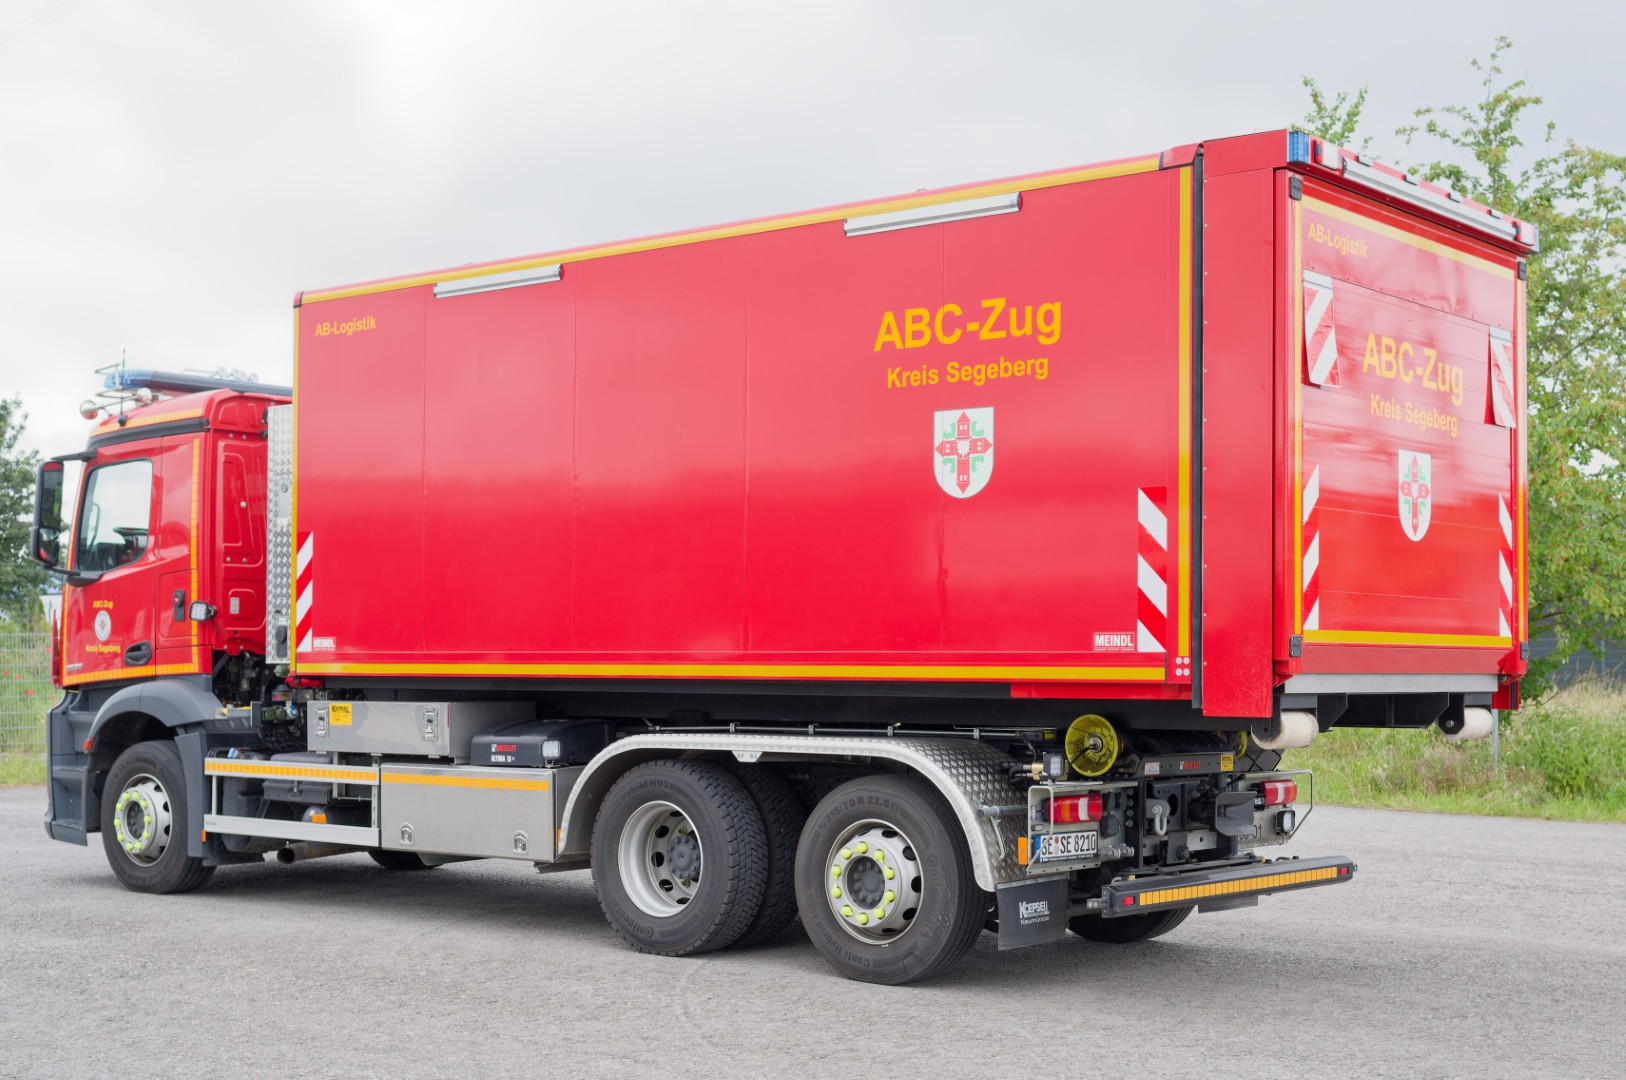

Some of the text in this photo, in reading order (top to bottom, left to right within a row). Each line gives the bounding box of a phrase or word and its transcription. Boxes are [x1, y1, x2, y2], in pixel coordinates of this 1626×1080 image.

[1308, 221, 1369, 259] AB-Logistik
[315, 315, 376, 336] AB-Logistik
[874, 297, 1062, 352] ABC-Zug
[887, 357, 1049, 389] Kreis Segeberg
[1362, 332, 1465, 407] ABC-Zug
[1370, 393, 1459, 438] Kreis Segeberg
[93, 600, 113, 609] ABC-Zug
[98, 643, 121, 654] Segeberg
[313, 637, 336, 648] MEINDL
[1095, 634, 1134, 647] MEINDL
[824, 799, 856, 822] 315/70
[858, 796, 866, 806] R
[867, 795, 890, 808] 22.5
[1060, 836, 1072, 854] SE
[1074, 833, 1096, 852] 8210
